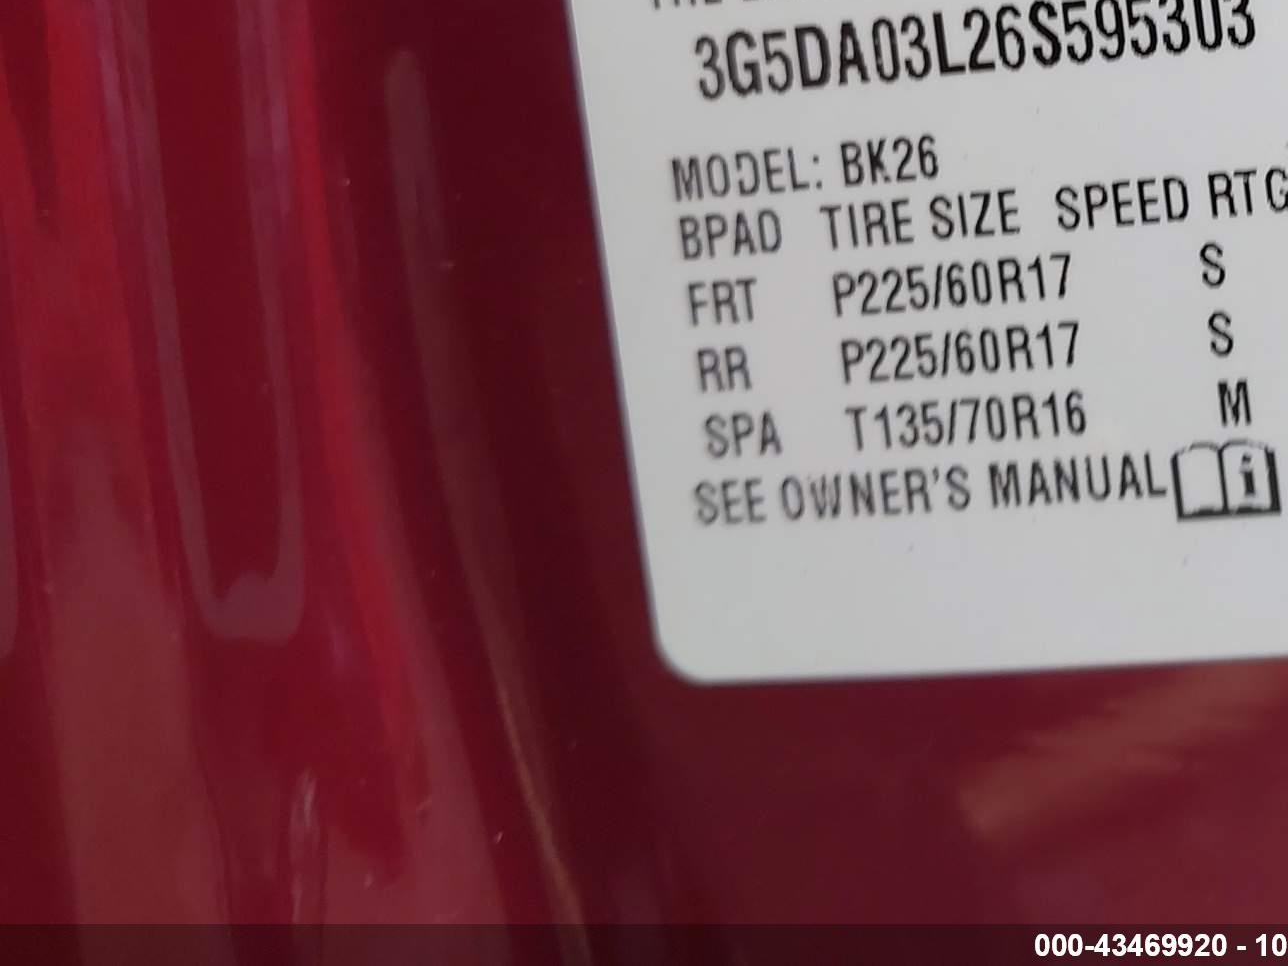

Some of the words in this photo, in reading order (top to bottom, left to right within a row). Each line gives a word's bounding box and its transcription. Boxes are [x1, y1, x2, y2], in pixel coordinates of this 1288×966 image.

[671, 147, 823, 203] MODEL:
[839, 133, 939, 188] BK26
[819, 197, 915, 251] TIRE
[928, 188, 1021, 241] SIZE
[1054, 175, 1190, 232] SPEED
[687, 277, 757, 326] FRT
[832, 252, 1071, 318] P225/60R17
[1199, 241, 1226, 289] S
[696, 345, 752, 392] RR
[840, 320, 1080, 385] P225/60R17
[1207, 310, 1235, 358] S
[704, 411, 782, 459] SPA
[844, 389, 1087, 451] T135/70R16
[1217, 378, 1253, 428] M
[693, 478, 765, 526] SEE
[779, 465, 971, 521] OWNER'S
[988, 451, 1168, 509] MANUAL
